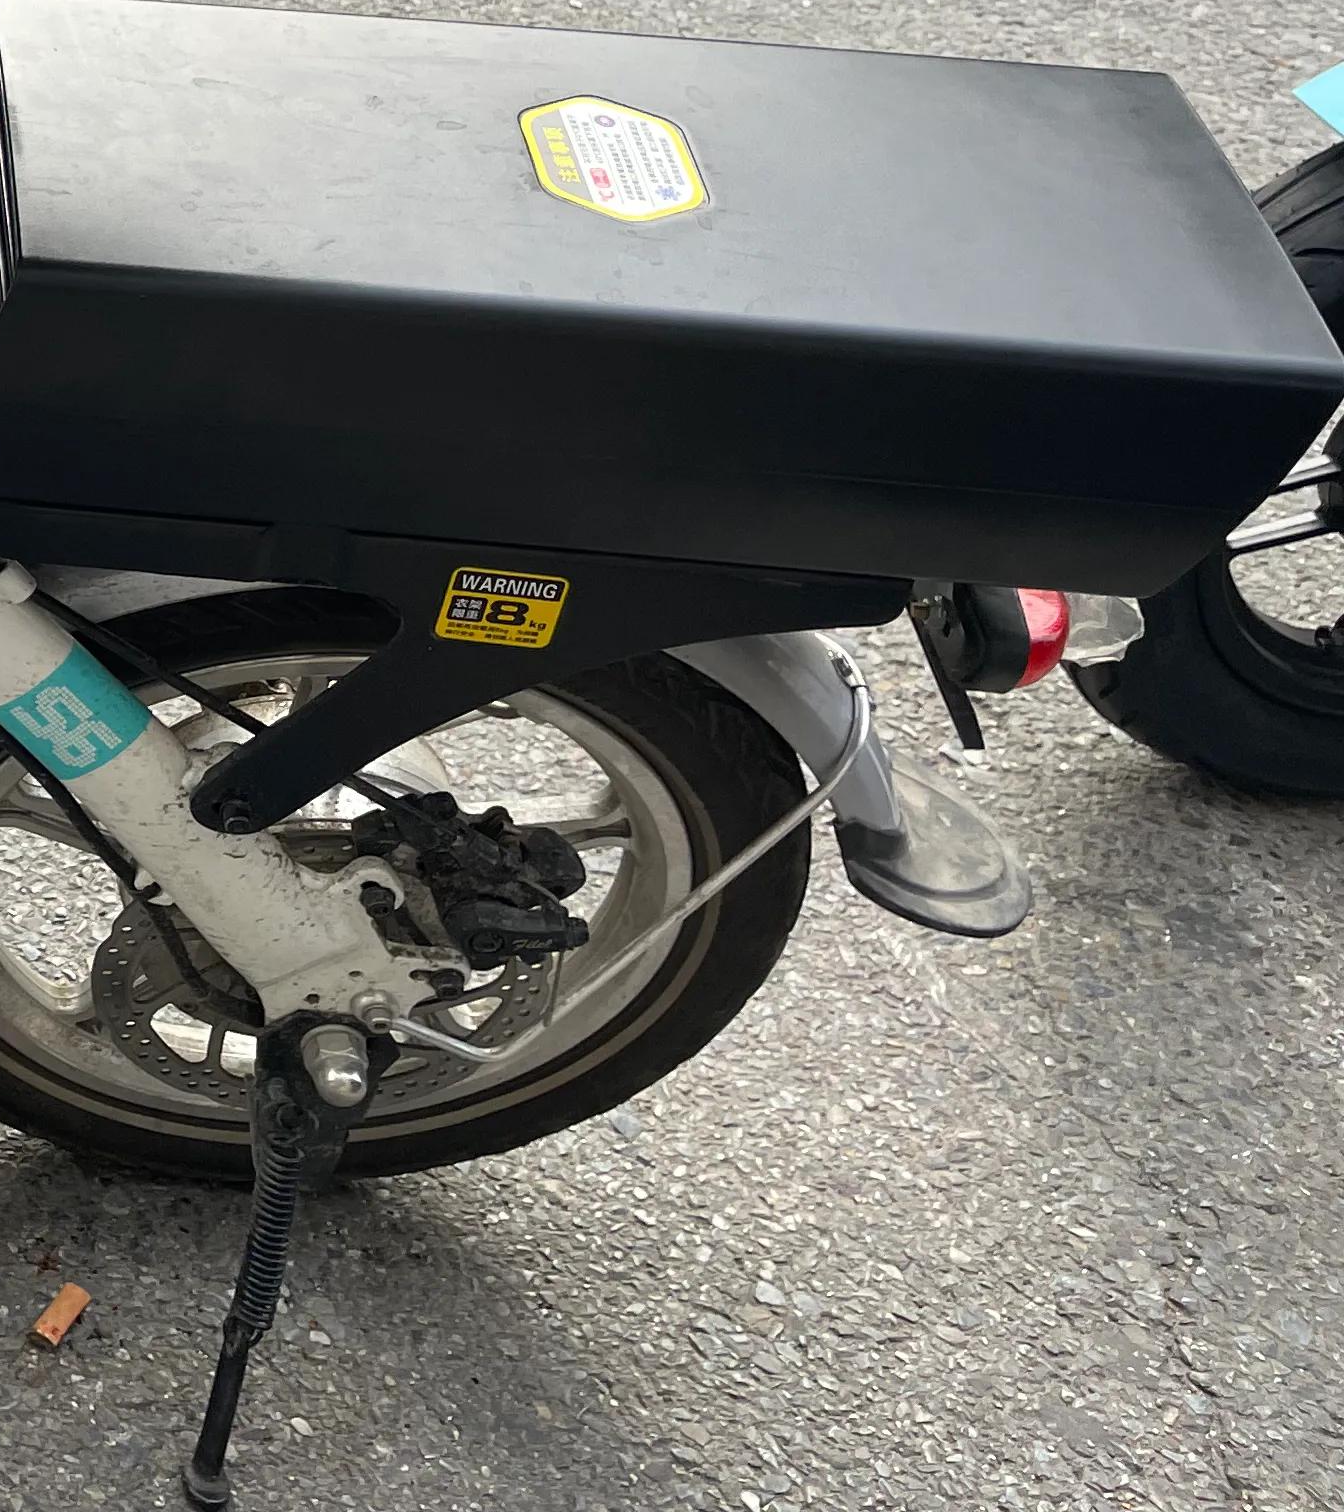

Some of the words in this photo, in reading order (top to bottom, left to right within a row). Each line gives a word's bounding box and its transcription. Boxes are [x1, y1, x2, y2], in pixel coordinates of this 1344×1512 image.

[461, 573, 559, 600] WARNING
[485, 599, 530, 626] 8
[528, 619, 547, 631] kg
